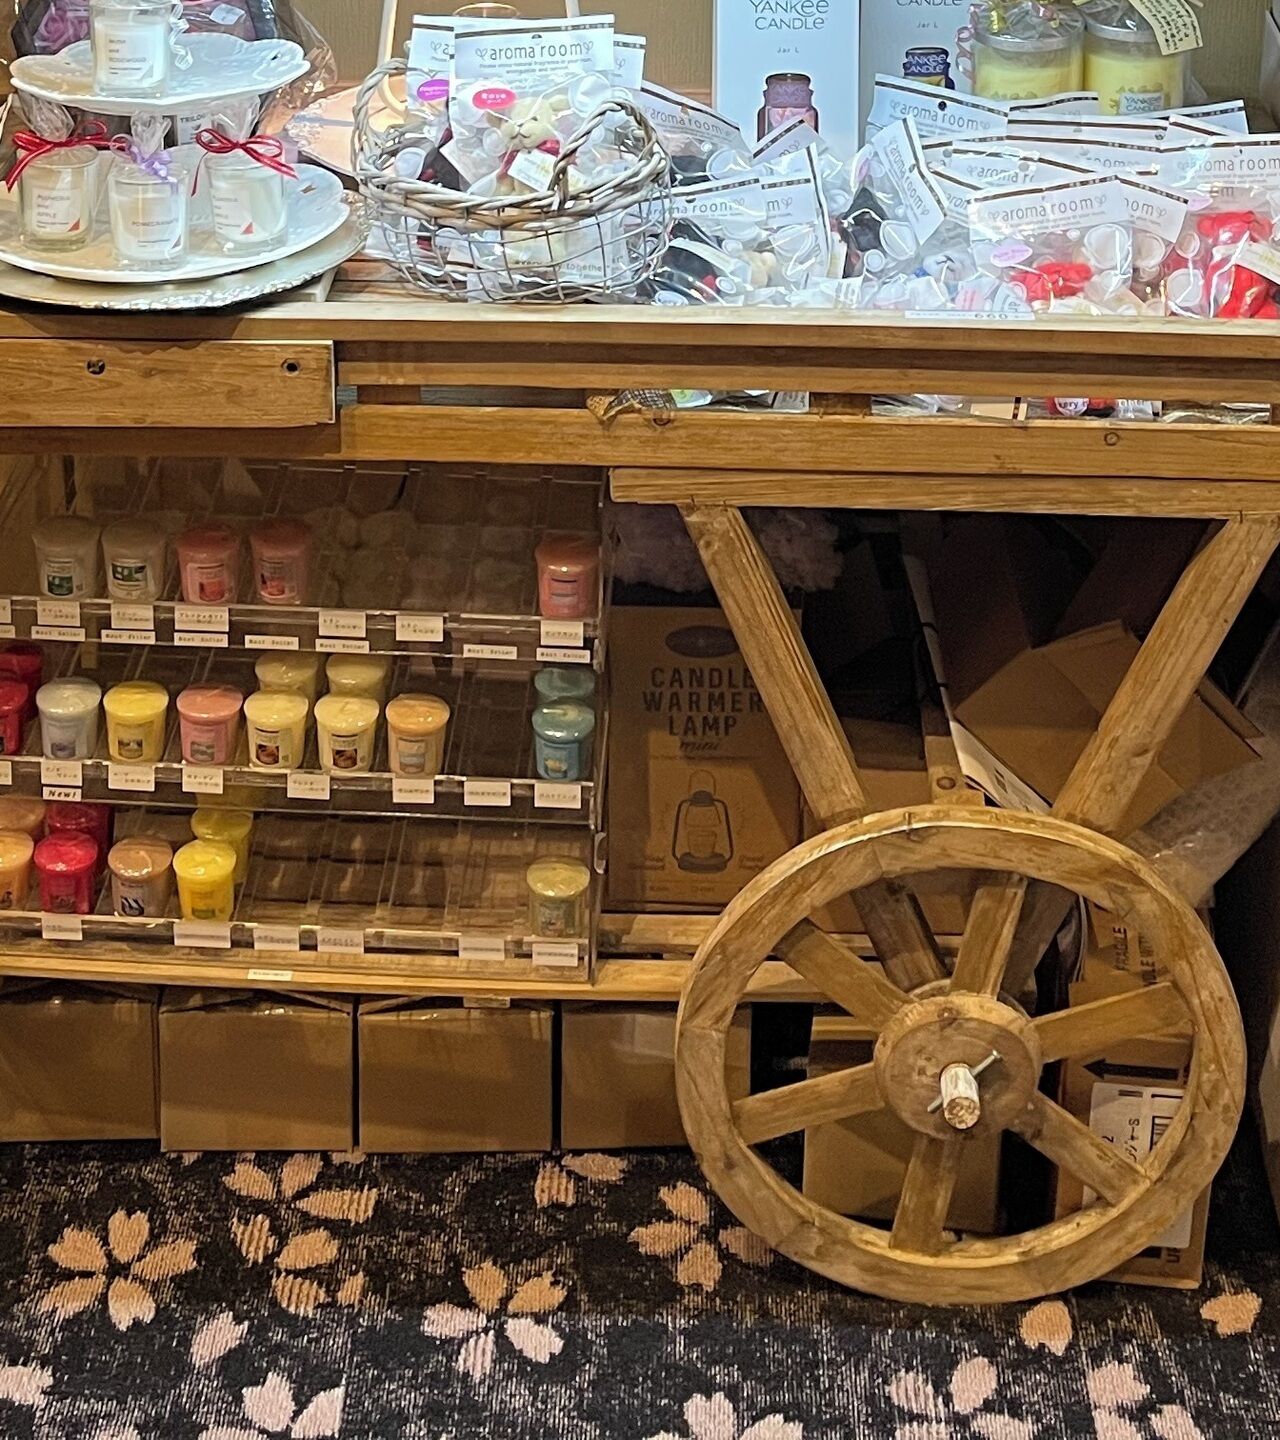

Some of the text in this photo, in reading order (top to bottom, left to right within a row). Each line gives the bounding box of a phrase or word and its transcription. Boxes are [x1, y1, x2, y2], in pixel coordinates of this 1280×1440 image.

[490, 41, 583, 60] aroma room
[650, 107, 722, 134] aroma room
[900, 103, 979, 130] aroma room
[1002, 196, 1094, 222] aroma room
[650, 667, 755, 689] CANDLE
[643, 691, 765, 713] WARMER
[669, 715, 737, 737] LAMP
[48, 789, 77, 800] New!
